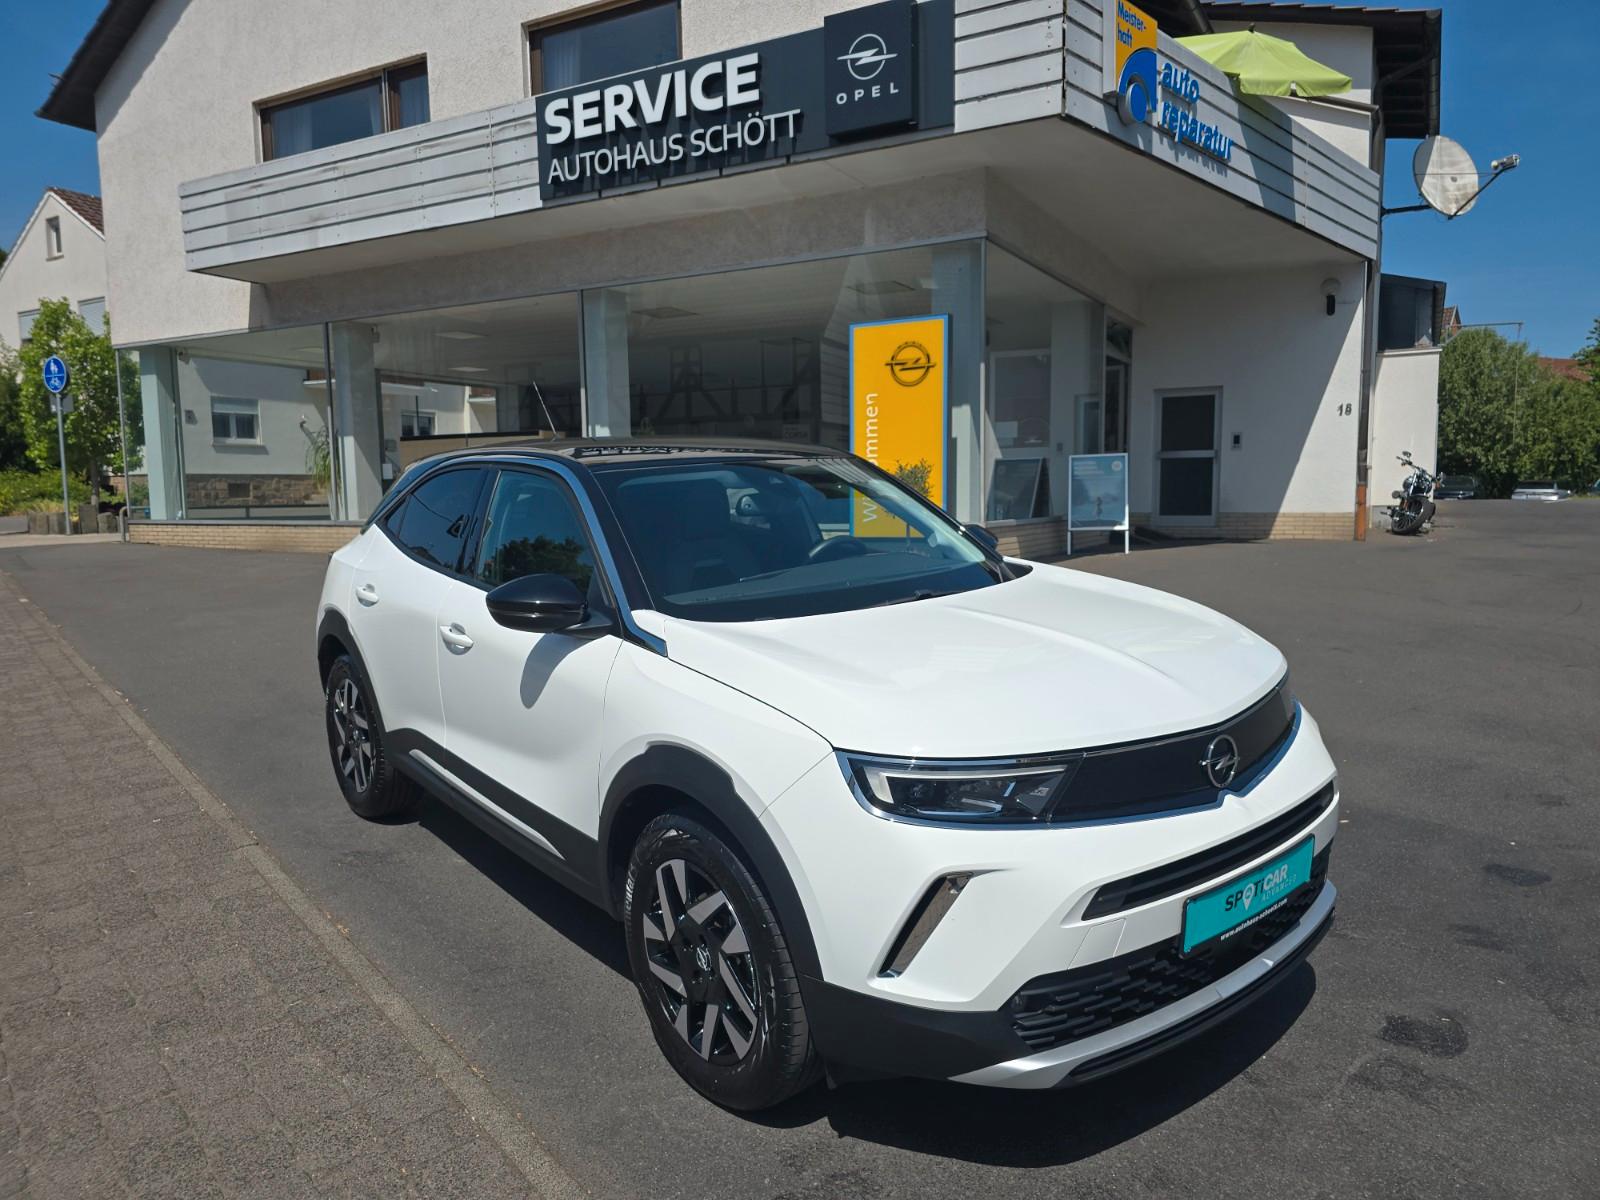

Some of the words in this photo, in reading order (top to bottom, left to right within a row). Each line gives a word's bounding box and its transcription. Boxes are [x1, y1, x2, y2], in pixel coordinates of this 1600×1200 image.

[1118, 0, 1146, 32] Meister-
[1118, 22, 1133, 48] haft
[544, 52, 760, 145] SERVICE
[836, 81, 899, 105] OPEL
[1161, 62, 1200, 104] auto
[547, 133, 684, 184] AUTOHAUS
[689, 109, 801, 157] SCHÖTT
[1160, 101, 1234, 162] reparatur
[1336, 403, 1352, 416] 18
[863, 392, 879, 522] Wmmen
